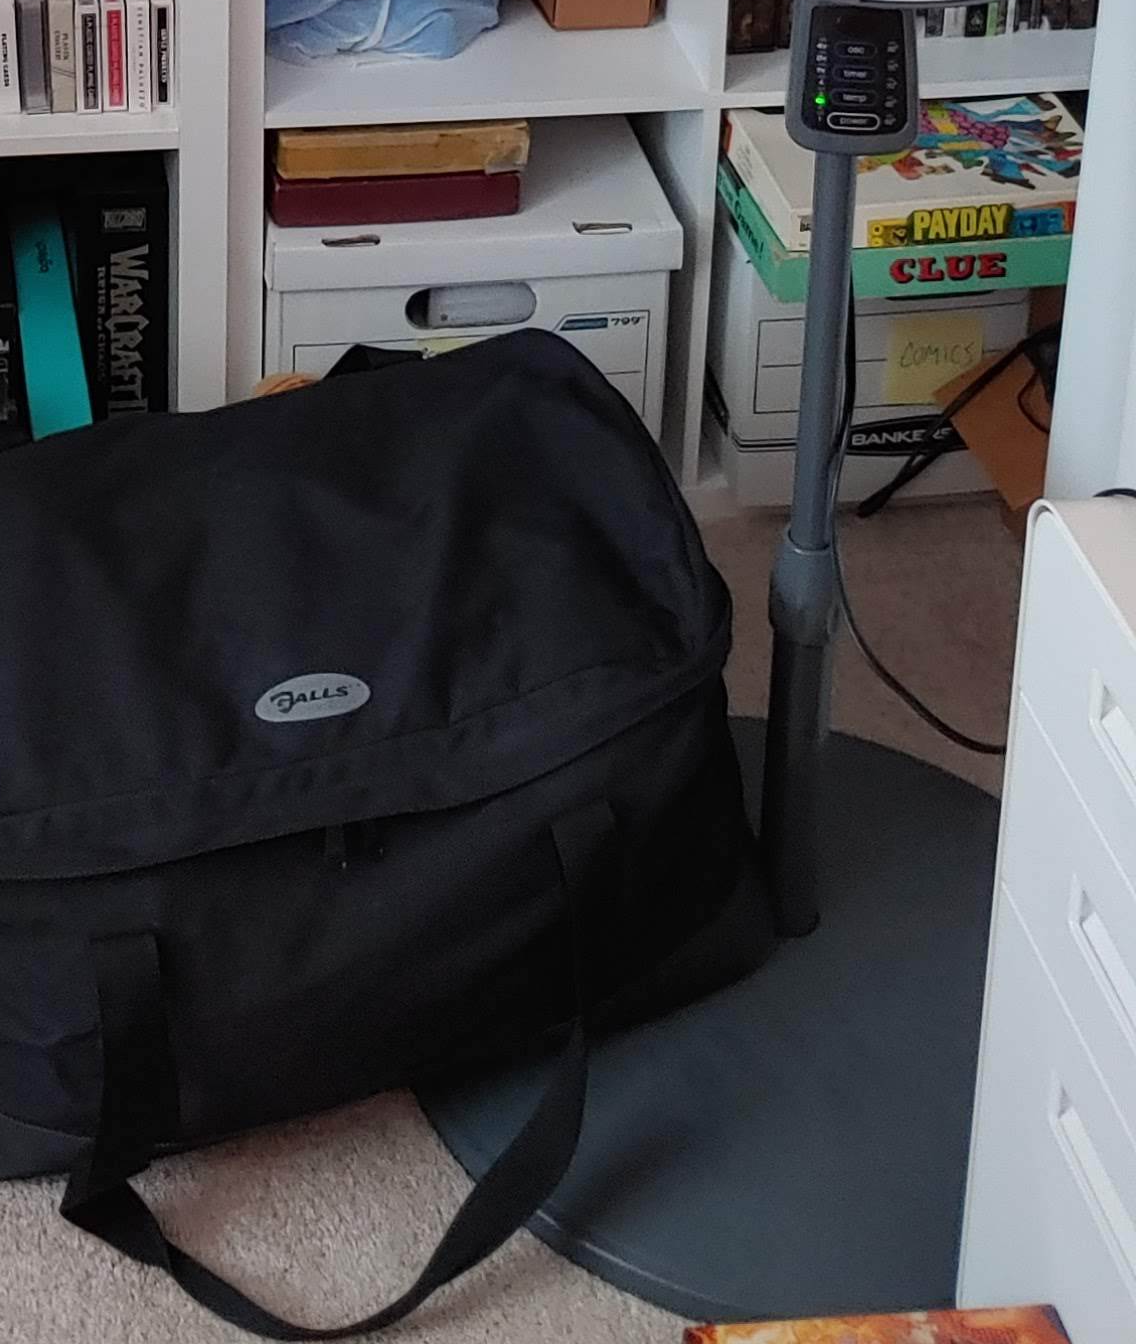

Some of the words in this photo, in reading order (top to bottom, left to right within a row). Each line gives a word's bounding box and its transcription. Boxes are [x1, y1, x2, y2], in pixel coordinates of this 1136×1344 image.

[913, 206, 1011, 242] PAYDAY
[889, 252, 1008, 285] CLUE
[105, 244, 151, 402] WARCRAFT
